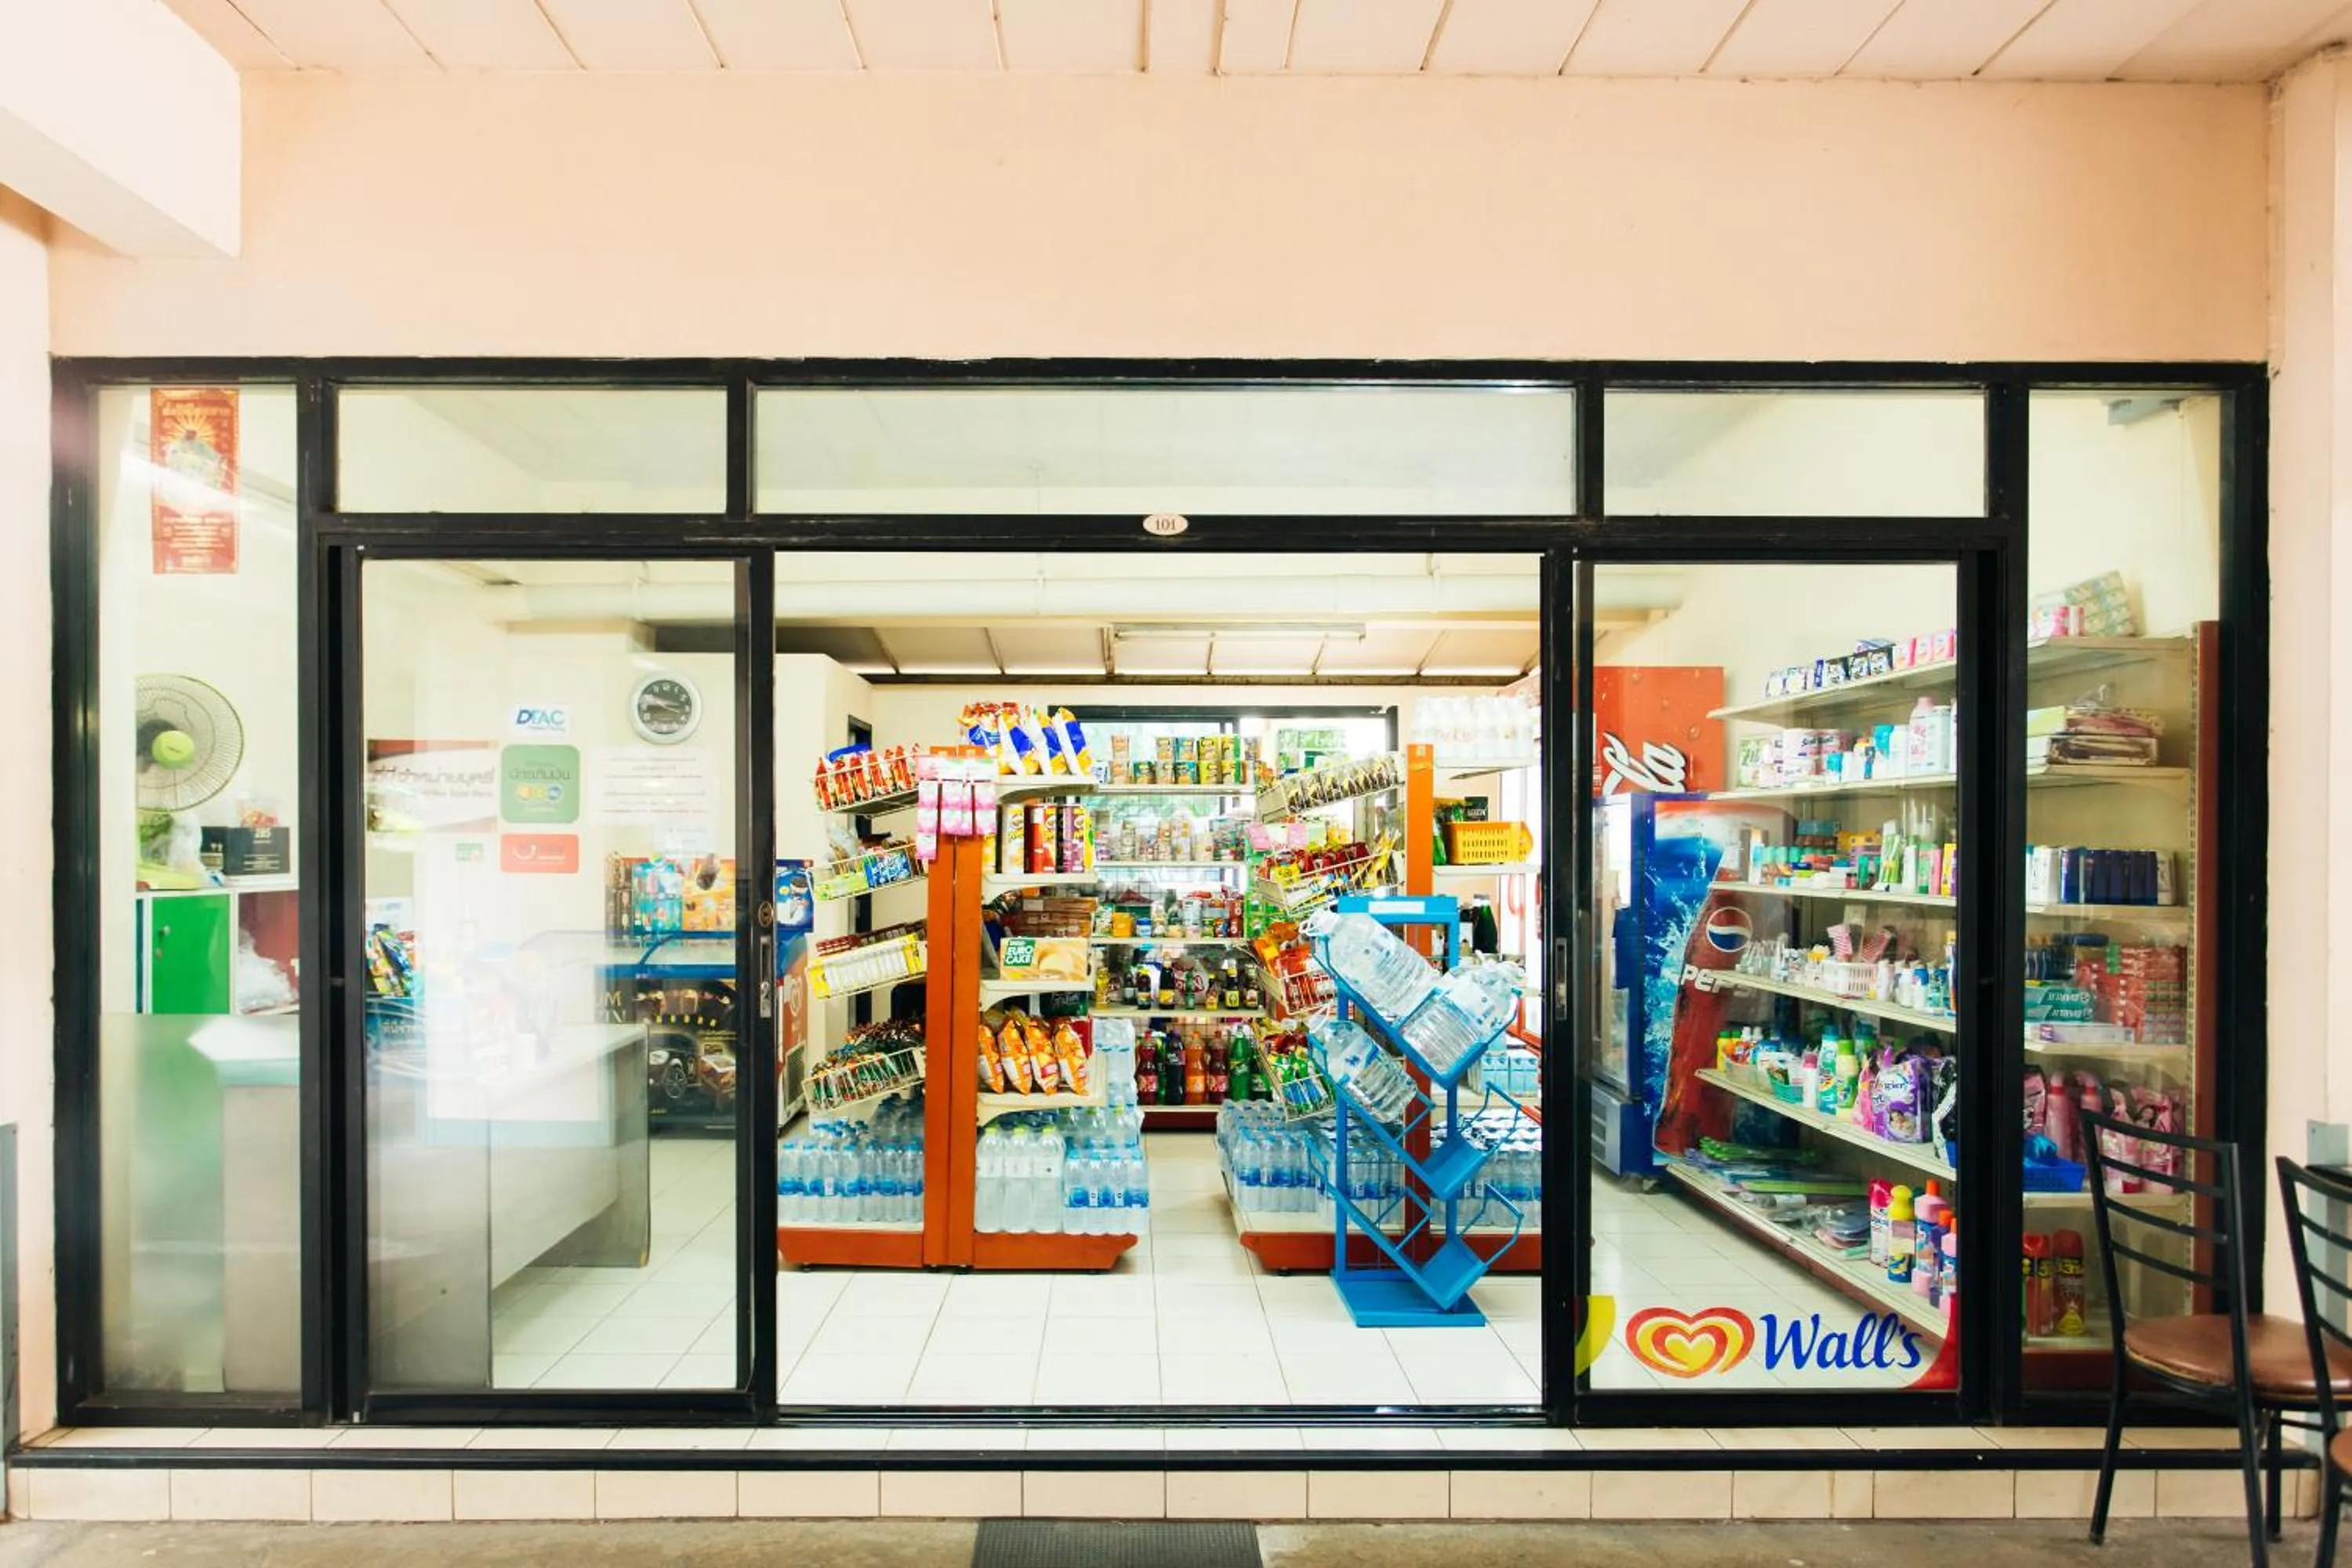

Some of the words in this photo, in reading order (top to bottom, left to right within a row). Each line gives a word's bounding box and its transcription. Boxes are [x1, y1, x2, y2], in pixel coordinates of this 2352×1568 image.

[1156, 519, 1176, 531] 101
[516, 709, 564, 725] DTAC
[1007, 946, 1033, 956] EURO
[1005, 953, 1032, 964] CAKE
[1759, 1312, 1925, 1370] Wall's
